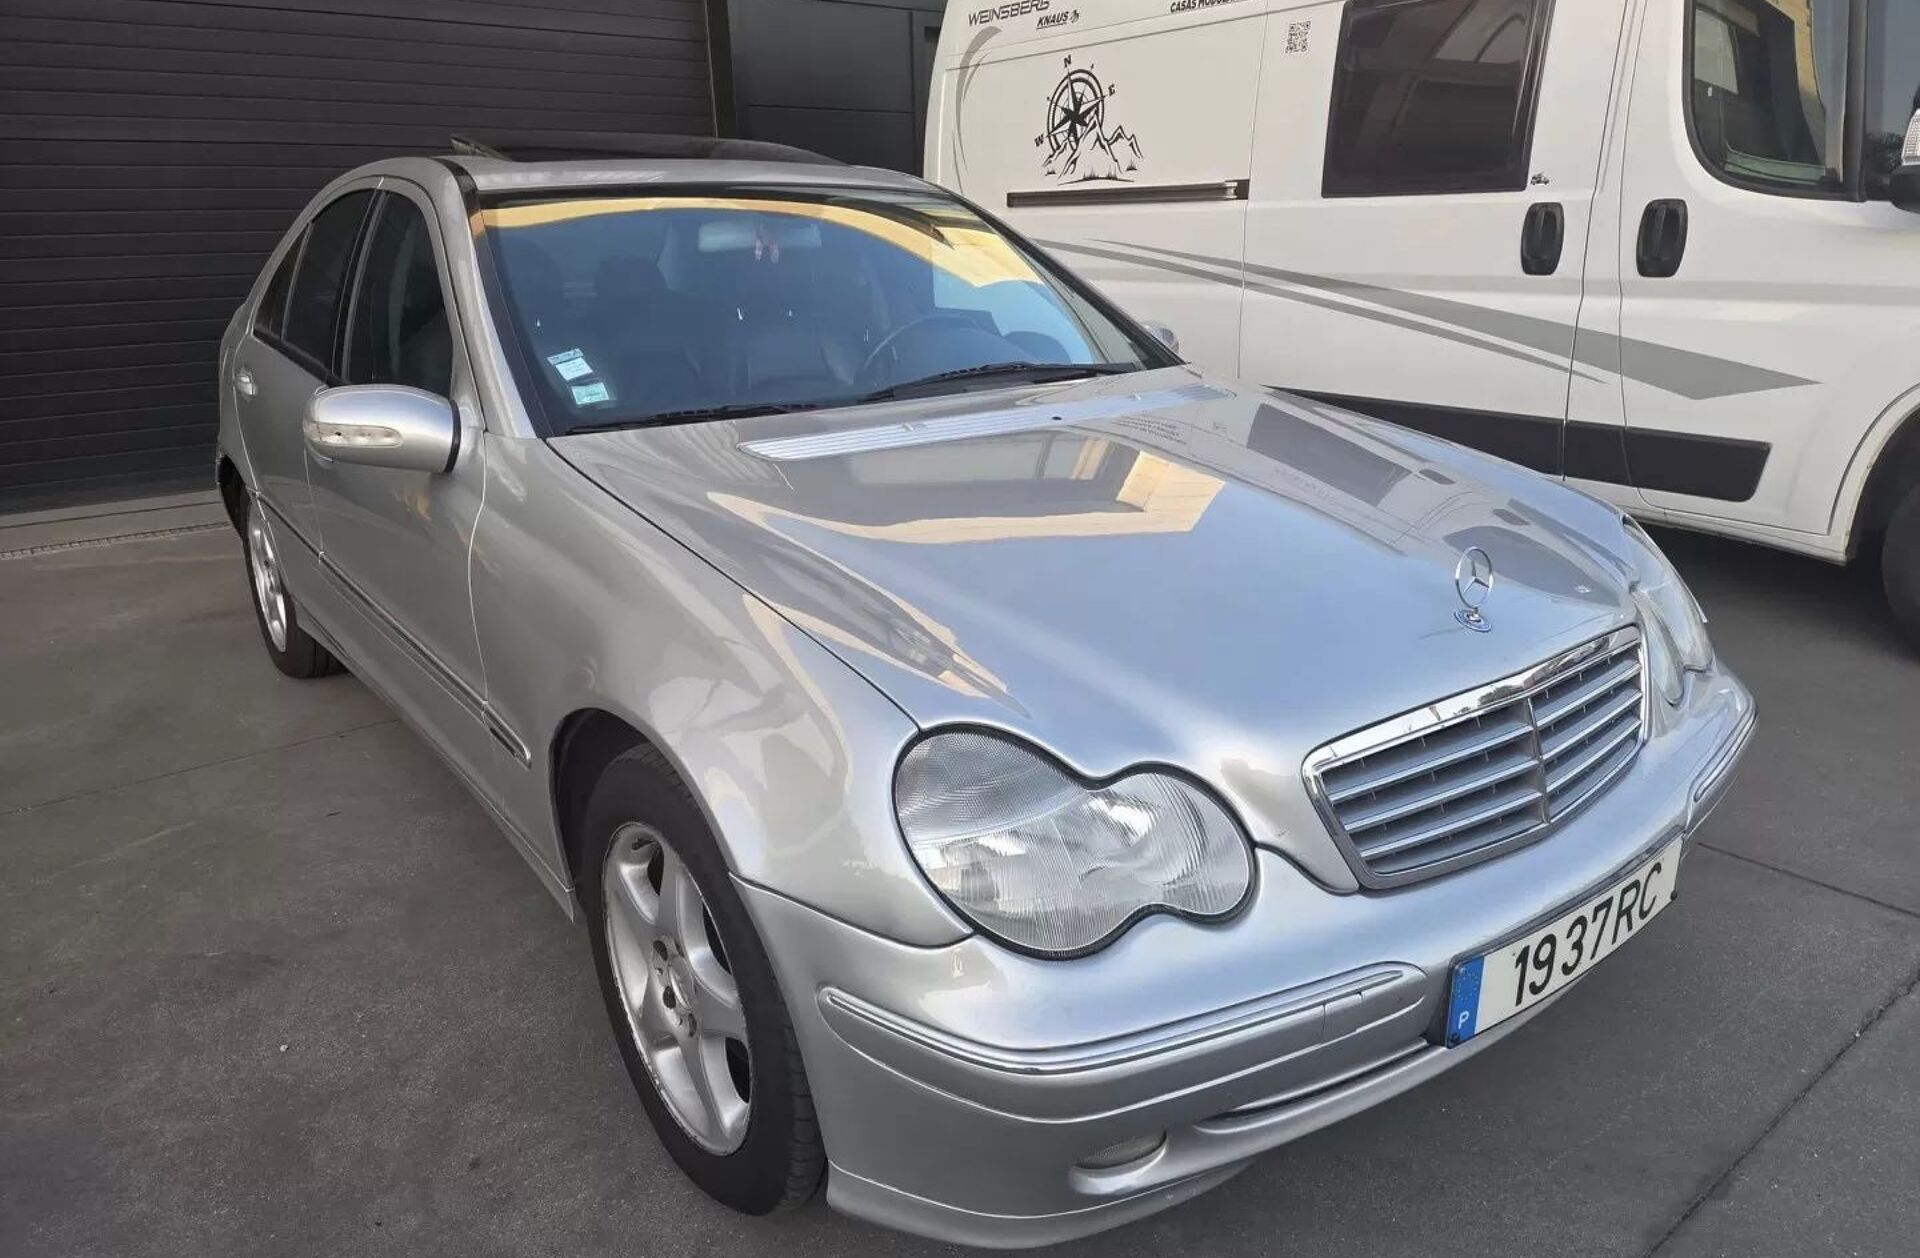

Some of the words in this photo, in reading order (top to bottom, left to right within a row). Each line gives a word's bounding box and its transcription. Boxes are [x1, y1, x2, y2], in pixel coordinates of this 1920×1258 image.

[1170, 0, 1197, 13] CASAS
[1036, 11, 1069, 28] KNAUS
[1063, 54, 1072, 68] N
[1108, 84, 1116, 97] E
[1034, 133, 1044, 147] W
[1514, 861, 1662, 1007] 1937RC
[1457, 1010, 1470, 1030] P
